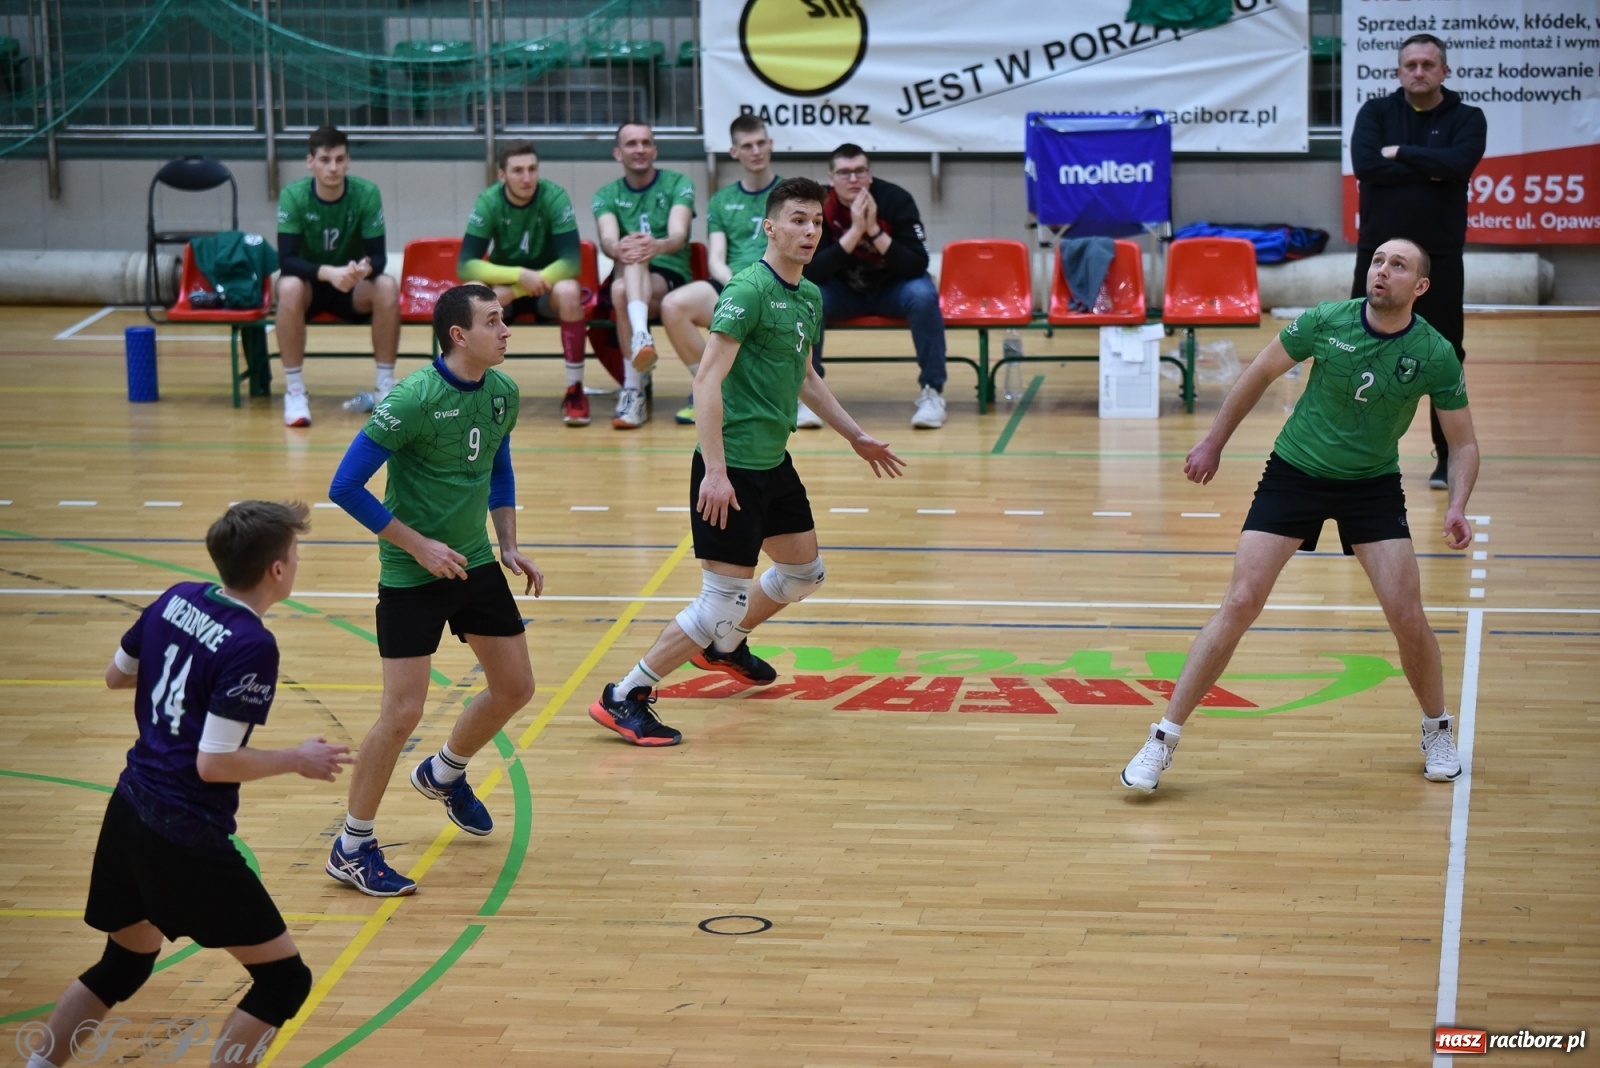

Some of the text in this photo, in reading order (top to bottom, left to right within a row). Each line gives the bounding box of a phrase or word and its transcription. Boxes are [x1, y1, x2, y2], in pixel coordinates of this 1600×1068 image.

[1357, 15, 1437, 34] Sprzedaż
[1441, 14, 1519, 32] zamków,
[1524, 13, 1591, 31] kłódek,
[1444, 36, 1495, 49] ównież
[1500, 36, 1552, 49] montaż
[1557, 35, 1561, 48] i
[1456, 67, 1493, 79] oraz
[1499, 62, 1593, 79] kodowanie
[896, 63, 984, 116] JEST
[996, 50, 1030, 83] W
[1357, 88, 1361, 102] i
[1458, 85, 1581, 104] mochodowych
[1059, 160, 1153, 185] molten
[1523, 174, 1584, 204] 555
[640, 213, 653, 236] 6
[751, 216, 763, 240] 7
[1467, 211, 1512, 229] clerc
[1515, 212, 1536, 229] ul.
[323, 227, 340, 251] 12
[520, 231, 529, 254] 4
[714, 297, 745, 320] Jura
[796, 322, 804, 353] 5
[1335, 340, 1356, 353] VIGO
[1354, 372, 1375, 403] 2
[441, 408, 459, 418] VIGO
[467, 427, 480, 461] 9
[151, 643, 193, 736] 14
[226, 673, 272, 701] Jura
